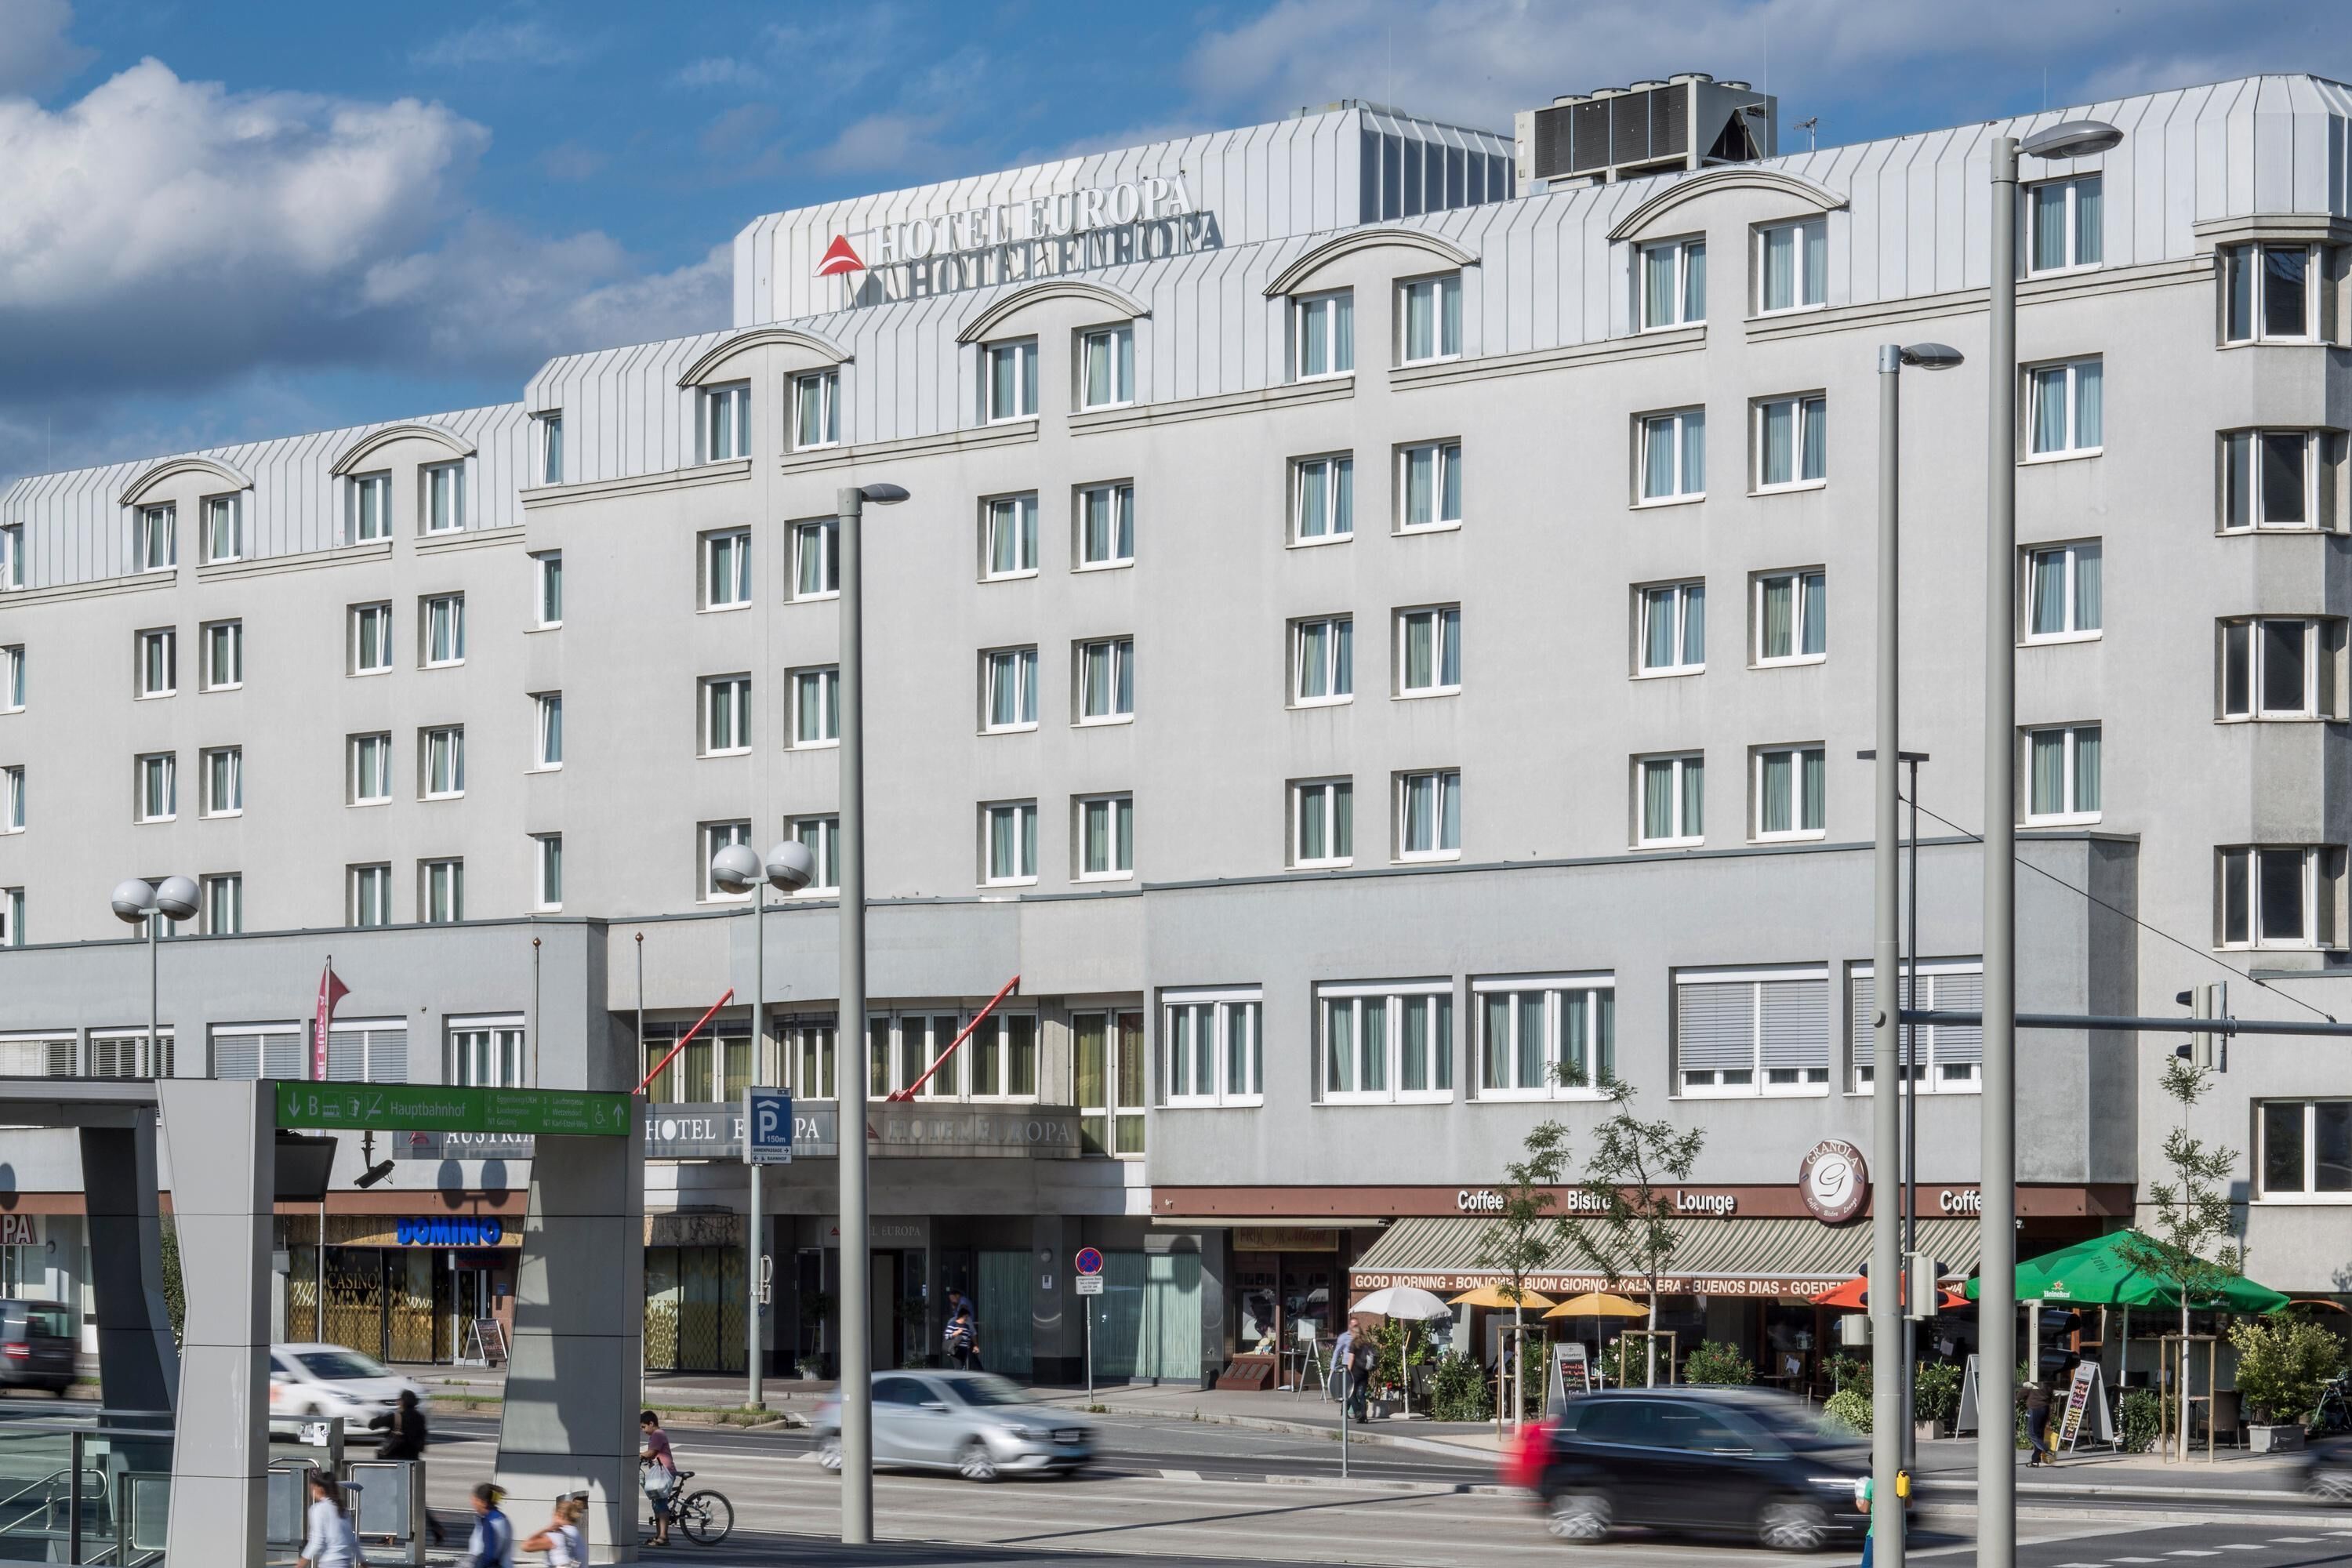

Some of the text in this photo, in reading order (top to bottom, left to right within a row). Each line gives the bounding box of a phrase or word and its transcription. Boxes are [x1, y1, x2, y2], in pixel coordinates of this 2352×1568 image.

[875, 176, 1192, 264] HOTEL EUROPA
[308, 1096, 466, 1119] B Hauptbahnhof
[645, 1119, 716, 1141] HOTEL
[759, 1110, 778, 1142] P
[978, 1119, 1070, 1142] EUROPA
[1806, 1142, 1859, 1168] GRANOLA
[1457, 1190, 1504, 1210] Coffee
[1677, 1190, 1734, 1214] Lounge
[1940, 1189, 1980, 1210] Coffe
[397, 1216, 503, 1246] DOMINO
[881, 1225, 922, 1236] EUROPA
[327, 1272, 377, 1290] CASINO
[1355, 1275, 1389, 1288] GOOD
[1392, 1275, 1446, 1288] MORNING
[1524, 1277, 1557, 1290] BUON
[1560, 1278, 1608, 1291] GIORNO
[1693, 1280, 1746, 1294] BUENOS
[1749, 1280, 1780, 1294] DIAS
